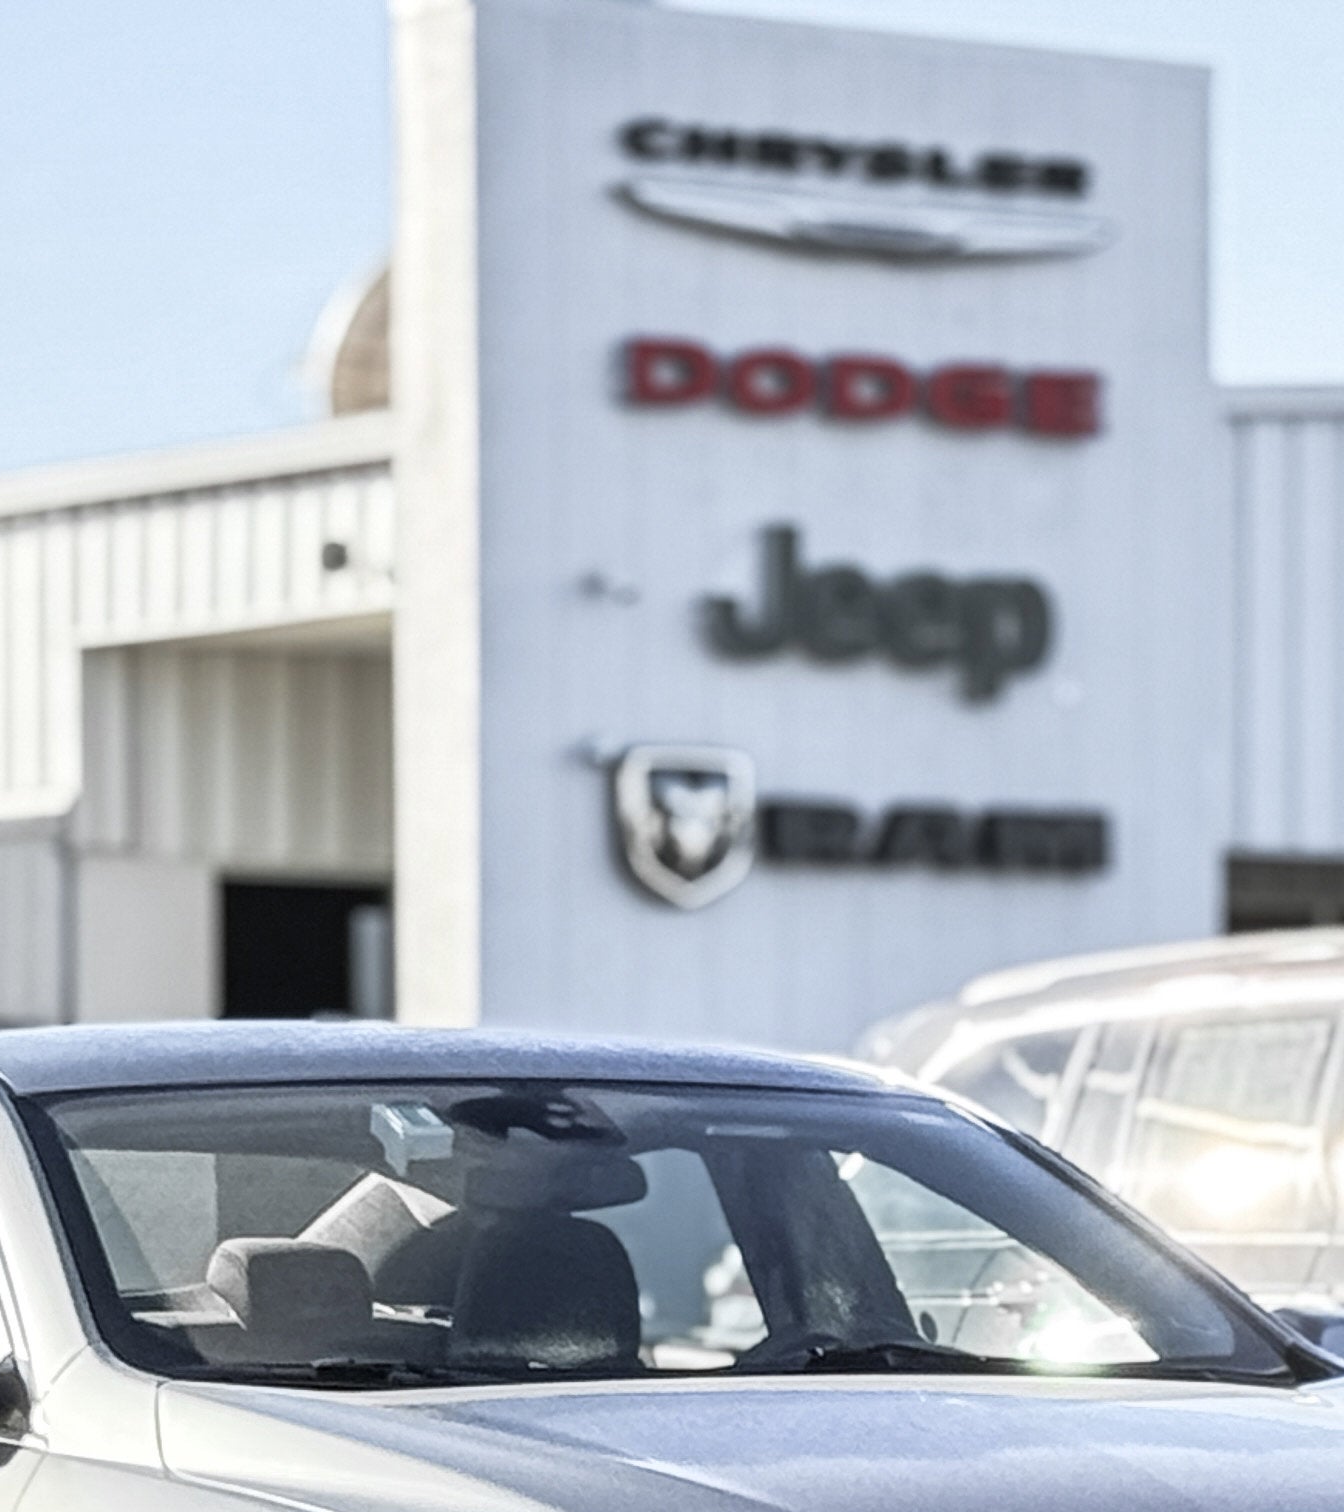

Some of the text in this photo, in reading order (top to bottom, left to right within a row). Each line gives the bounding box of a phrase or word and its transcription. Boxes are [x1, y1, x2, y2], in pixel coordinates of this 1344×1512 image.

[618, 116, 1090, 200] CHRYSLER
[620, 334, 1104, 438] DODGE
[699, 520, 1057, 706] Jeep
